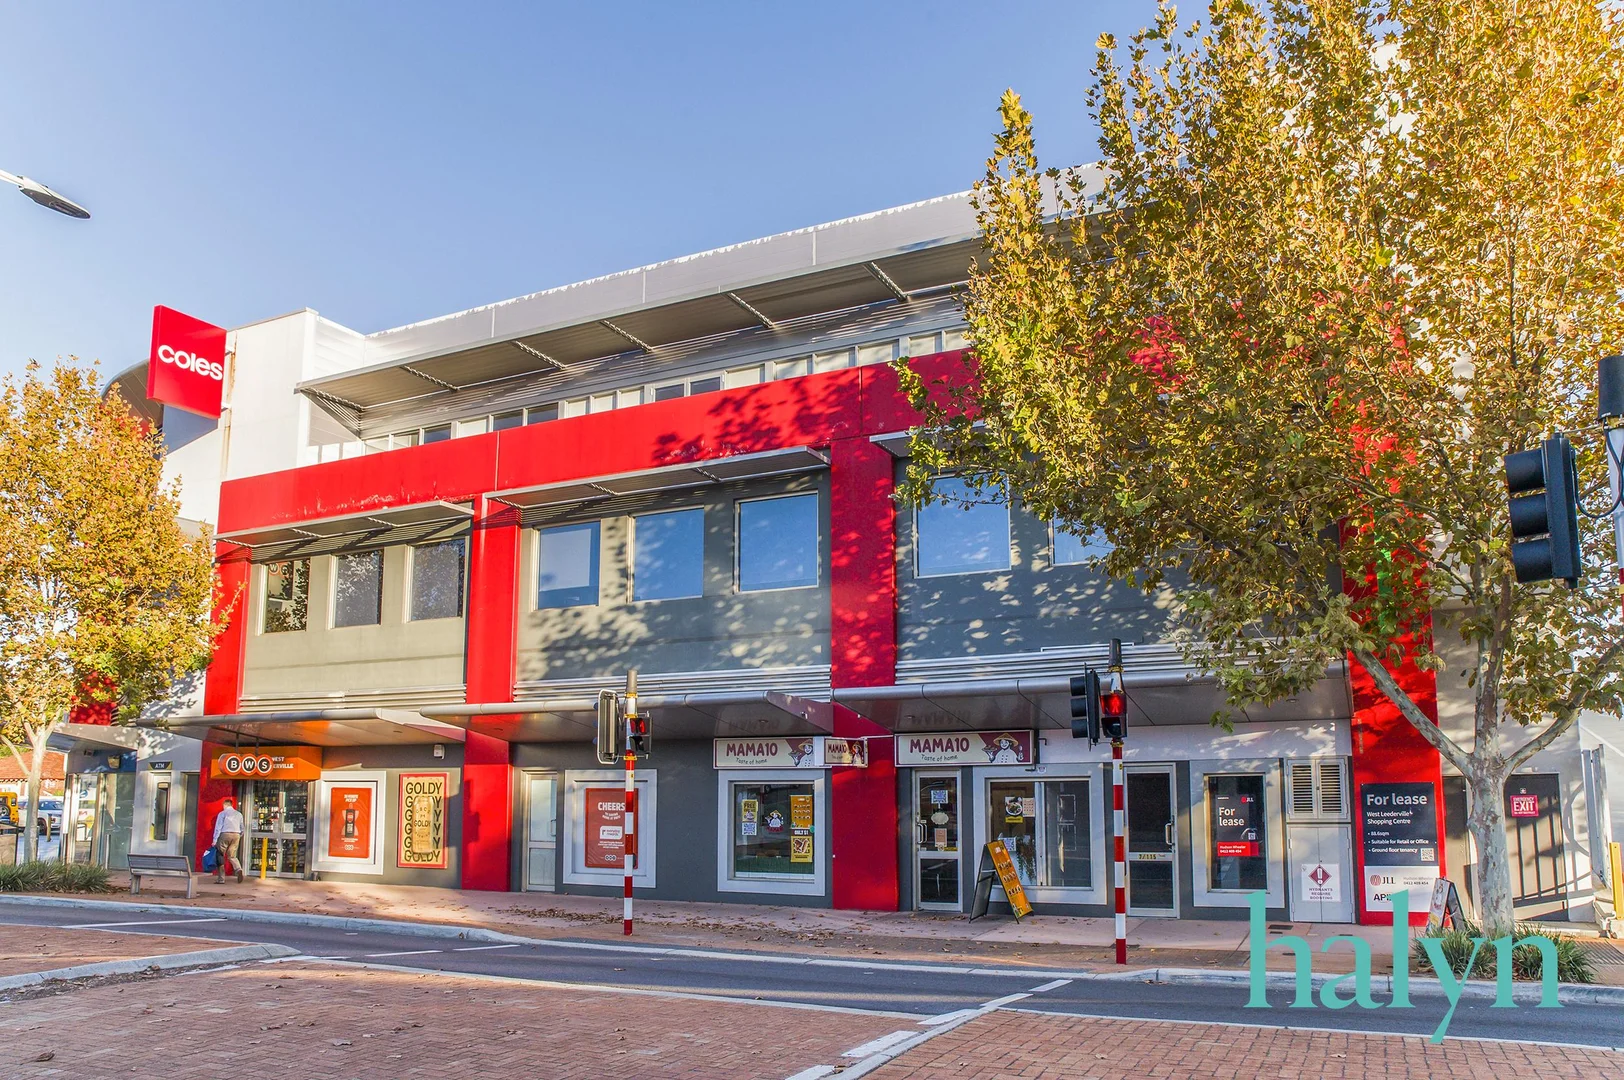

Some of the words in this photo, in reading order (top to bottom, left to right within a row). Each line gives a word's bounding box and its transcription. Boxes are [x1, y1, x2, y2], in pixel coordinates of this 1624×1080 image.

[158, 344, 223, 381] coles
[726, 742, 778, 757] MAMA10
[909, 737, 970, 753] MAMA10
[735, 757, 748, 765] Taste
[755, 757, 768, 765] home
[921, 754, 936, 762] Taste
[405, 782, 442, 795] GOLDY
[1367, 794, 1389, 805] For
[1392, 793, 1428, 805] lease
[598, 802, 625, 811] CHEERS
[1513, 801, 1534, 811] EXIT
[1219, 807, 1235, 816] For
[1219, 817, 1245, 826] lease
[1382, 876, 1396, 884] JLL
